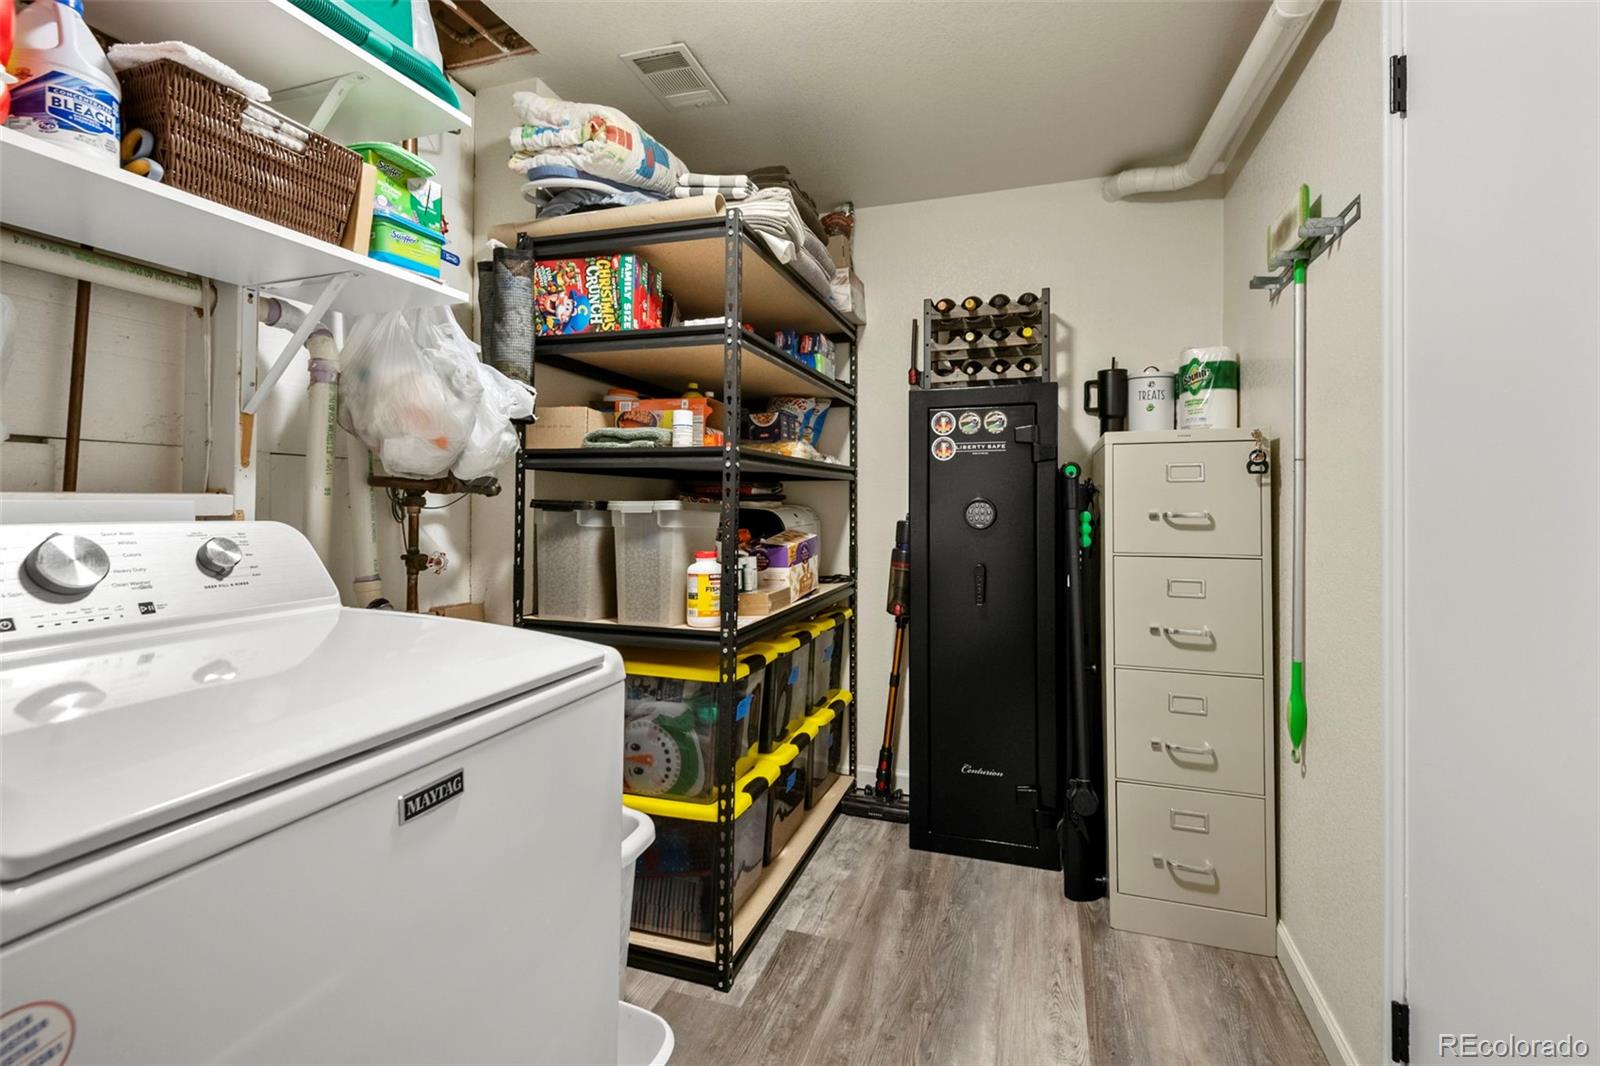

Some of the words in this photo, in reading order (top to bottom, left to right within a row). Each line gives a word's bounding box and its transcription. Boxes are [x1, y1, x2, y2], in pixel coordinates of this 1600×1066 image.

[51, 96, 113, 128] BLEACH
[391, 230, 417, 244] Swiffer
[623, 255, 633, 300] FAMILY
[585, 265, 603, 325] CRUNCH
[596, 259, 615, 331] CHRISTMAS
[623, 303, 632, 330] SIZE
[1138, 389, 1166, 401] TREATS
[961, 763, 1004, 777] Centurion
[406, 776, 462, 817] MAYTAG
